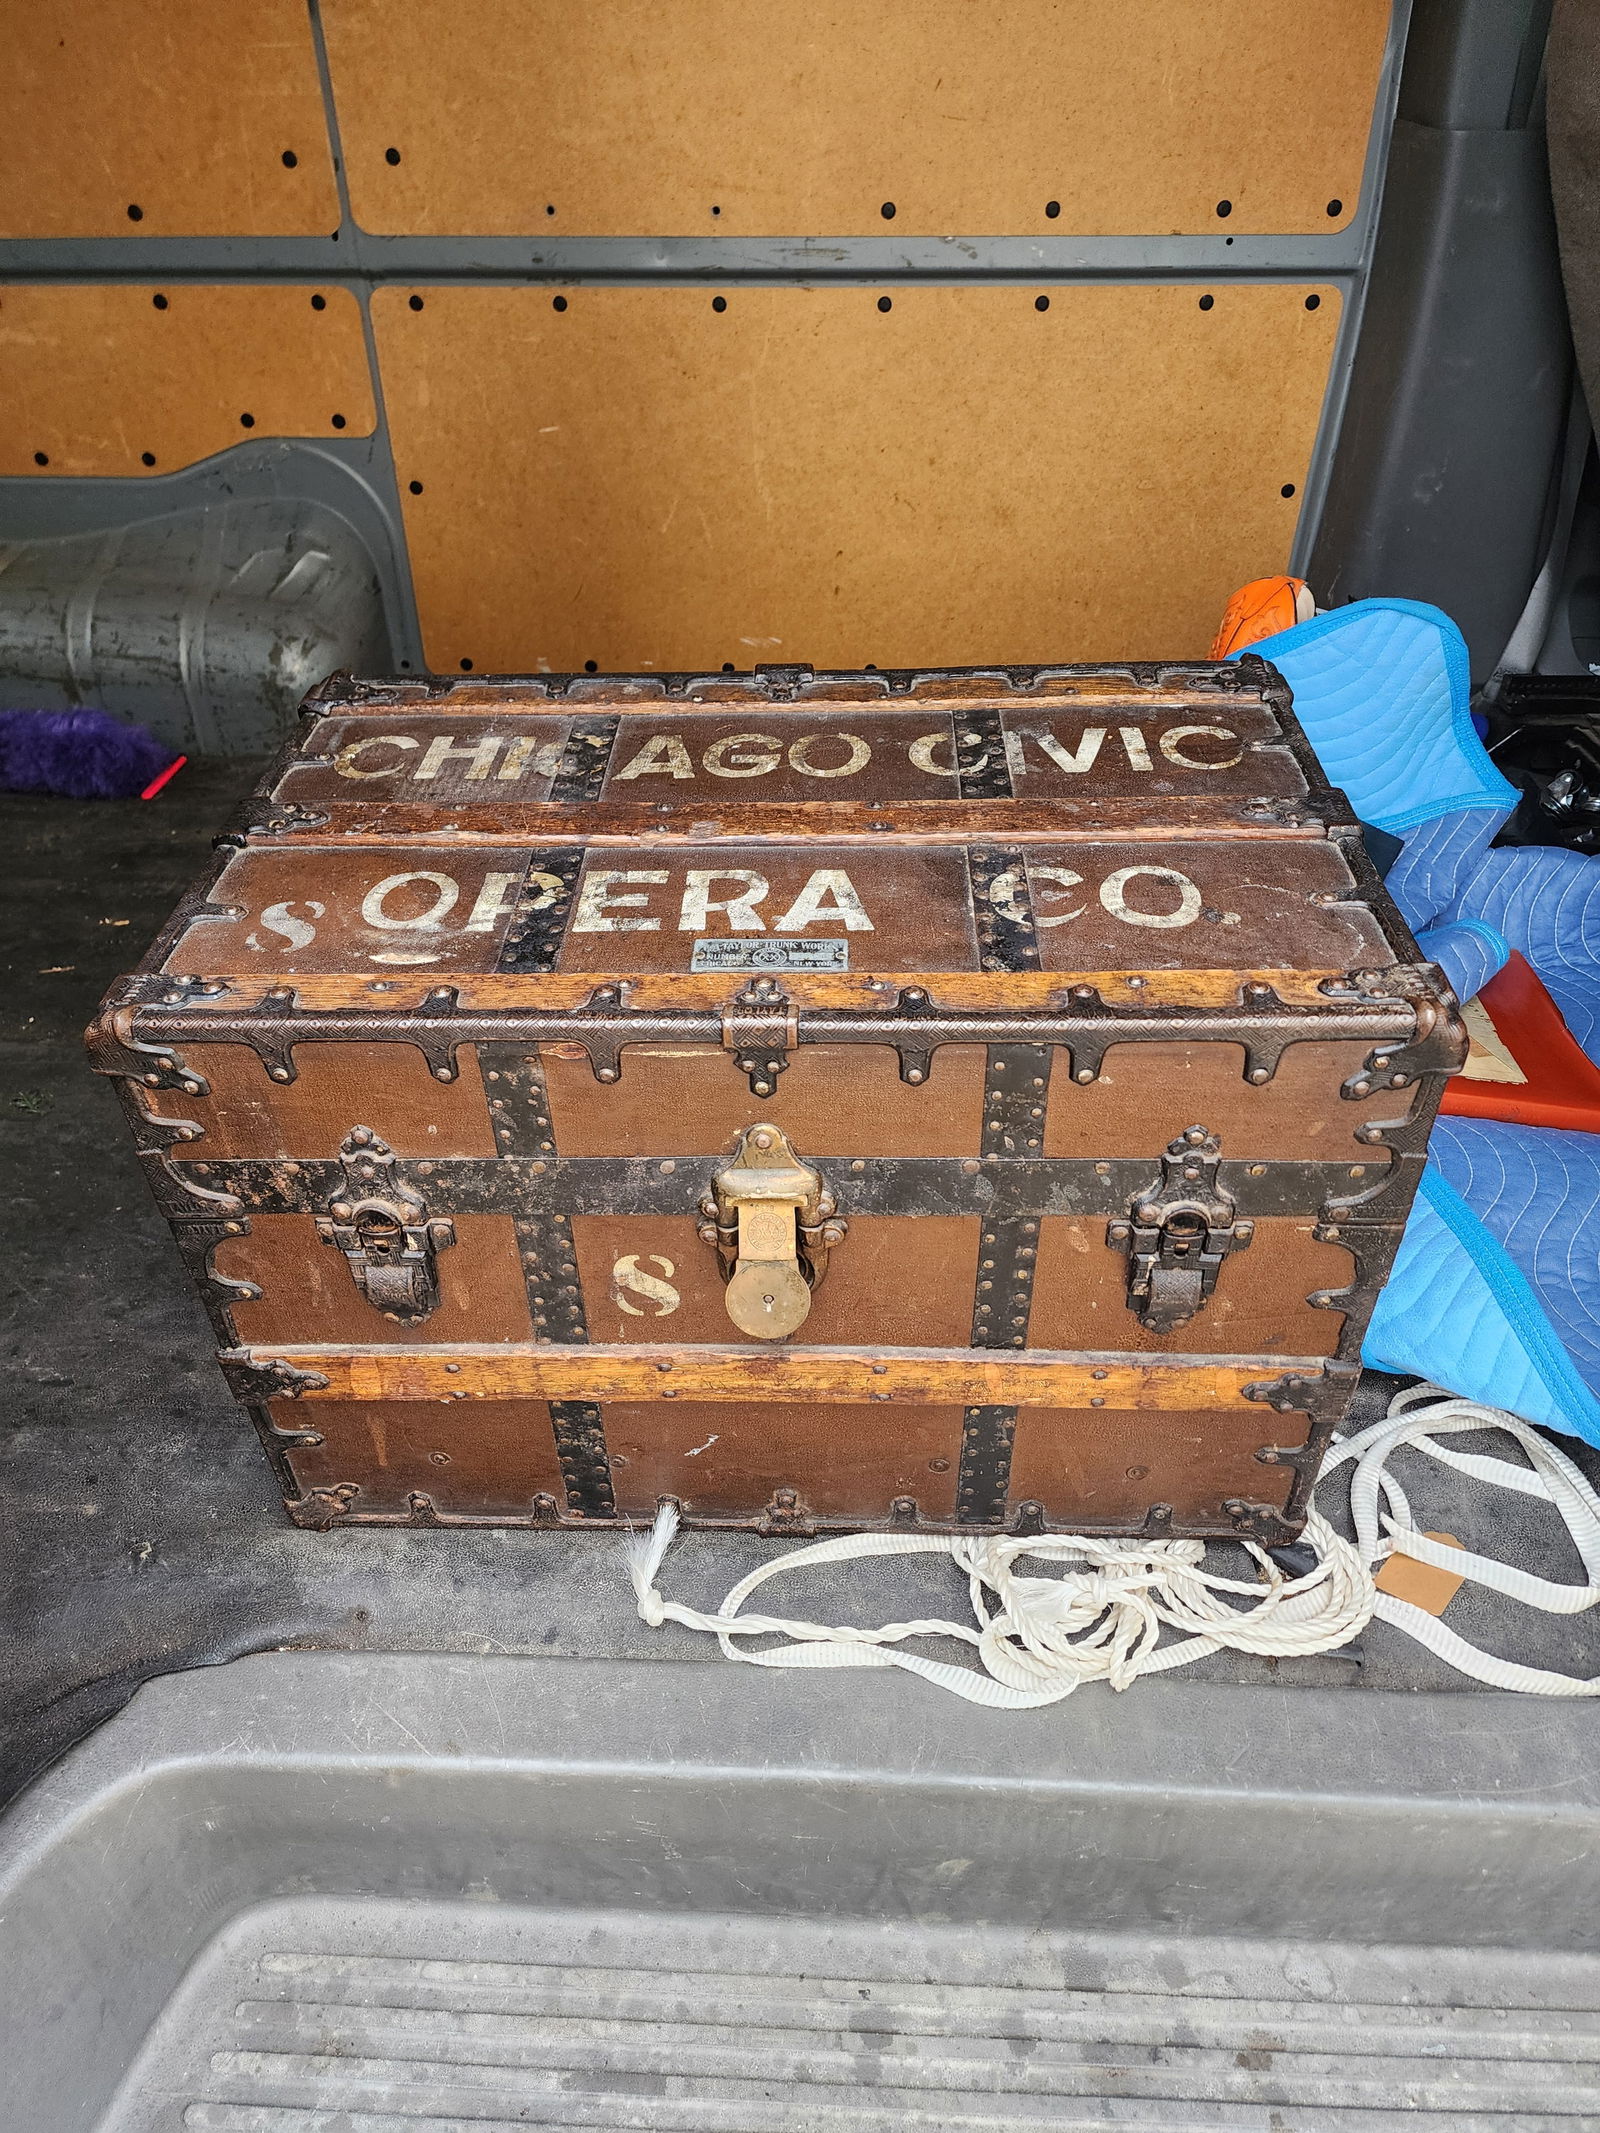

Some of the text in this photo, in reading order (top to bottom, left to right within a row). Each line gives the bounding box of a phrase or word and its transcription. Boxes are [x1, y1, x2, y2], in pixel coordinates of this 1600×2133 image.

[908, 725, 1244, 776] CIVIC
[245, 899, 327, 953] S
[360, 868, 876, 933] OPERA
[765, 941, 799, 949] TRUNK
[610, 1254, 681, 1317] S
